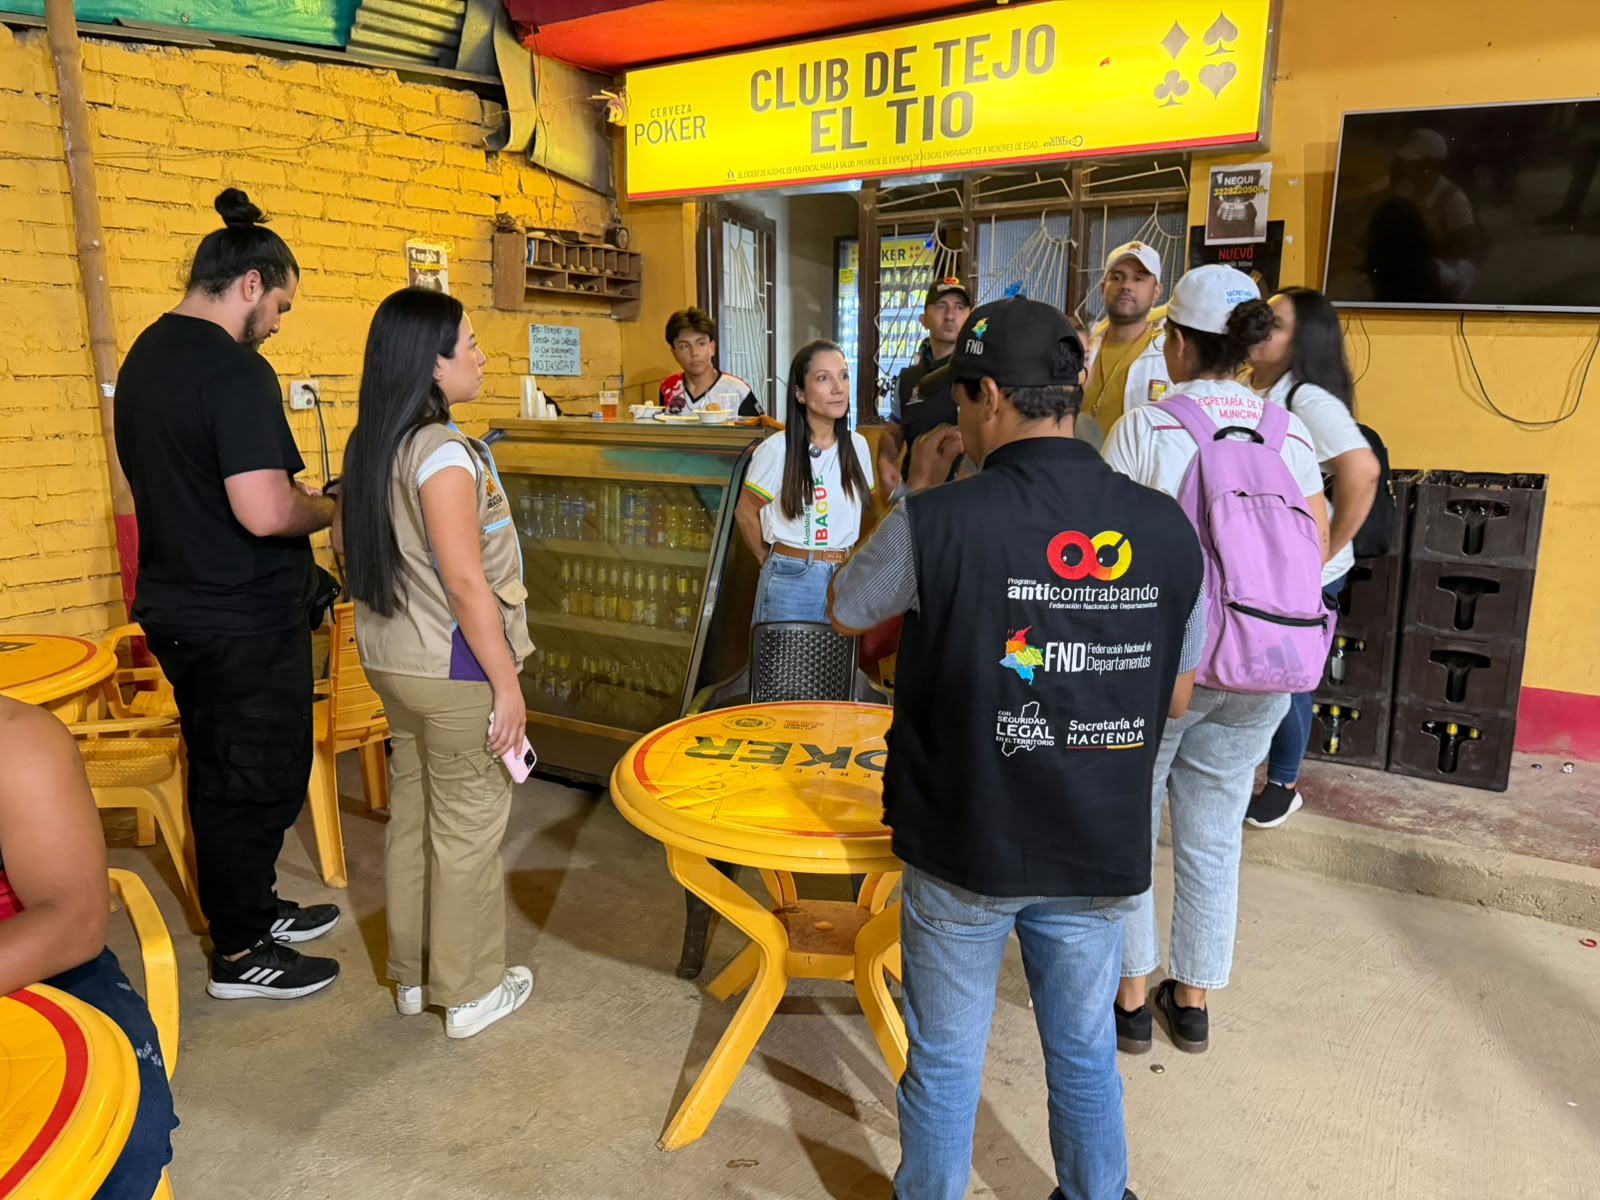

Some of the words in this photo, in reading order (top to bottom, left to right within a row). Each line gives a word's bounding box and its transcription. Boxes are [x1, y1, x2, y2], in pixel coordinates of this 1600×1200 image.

[751, 57, 849, 112] CLUB
[865, 45, 918, 98] DE
[933, 23, 1056, 88] TEJO
[650, 104, 692, 118] CERVEZA
[811, 106, 867, 154] EL
[886, 90, 974, 145] TIO
[634, 115, 706, 146] POKER
[1224, 175, 1254, 186] NEQUI
[881, 248, 906, 261] KER
[1218, 247, 1254, 260] NUEVO
[965, 339, 984, 355] FND
[532, 359, 544, 371] NO
[1247, 398, 1258, 409] DE
[1008, 577, 1037, 585] Programa
[1007, 583, 1159, 602] anticontrabando
[1049, 602, 1082, 610] Federación
[1083, 602, 1109, 611] Nacional
[1110, 602, 1118, 610] de
[1120, 602, 1158, 611] Departamentos
[1087, 642, 1123, 654] Federación
[1123, 641, 1146, 654] Nacional
[1146, 640, 1153, 652] de
[1044, 641, 1087, 672] FND
[1086, 654, 1151, 676] Departamentos
[1236, 662, 1311, 688] adidas
[997, 716, 1047, 725] SEGURIDAD
[1069, 717, 1130, 732] Secretaría
[1132, 716, 1145, 728] de
[997, 722, 1055, 739] LEGAL
[1067, 730, 1144, 745] HACIENDA
[1012, 738, 1054, 746] TERRITORIO
